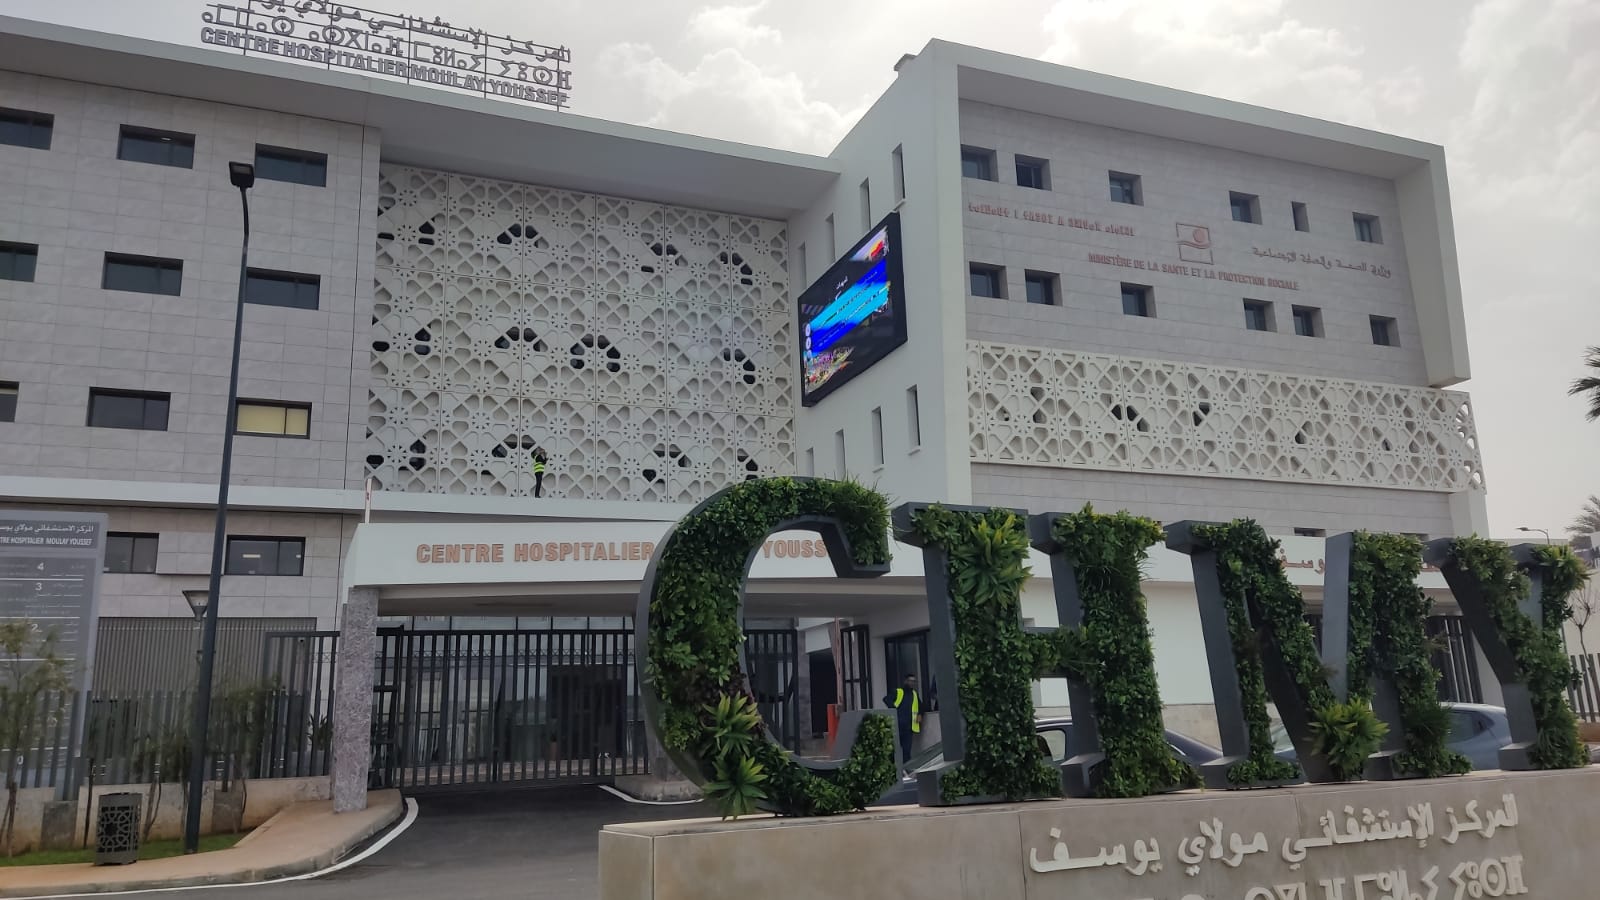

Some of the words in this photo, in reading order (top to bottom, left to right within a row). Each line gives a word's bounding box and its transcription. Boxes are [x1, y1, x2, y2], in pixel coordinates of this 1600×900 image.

[200, 26, 280, 54] CENTRE
[283, 40, 408, 77] HOSPITALIER
[410, 63, 485, 92] MOULAY
[489, 78, 567, 106] YOUSSEF
[1134, 260, 1145, 269] DE
[1147, 262, 1160, 272] LA
[1192, 268, 1201, 277] ET
[1204, 269, 1216, 280] LA
[36, 562, 44, 570] 4
[416, 543, 504, 563] CENTRE
[514, 541, 655, 562] HOSPITALIER
[762, 539, 827, 558] YOUSS
[35, 582, 42, 591] 3
[1441, 793, 1519, 845] المركز
[1029, 827, 1162, 876] يوسف
[1177, 816, 1269, 878] مولاي
